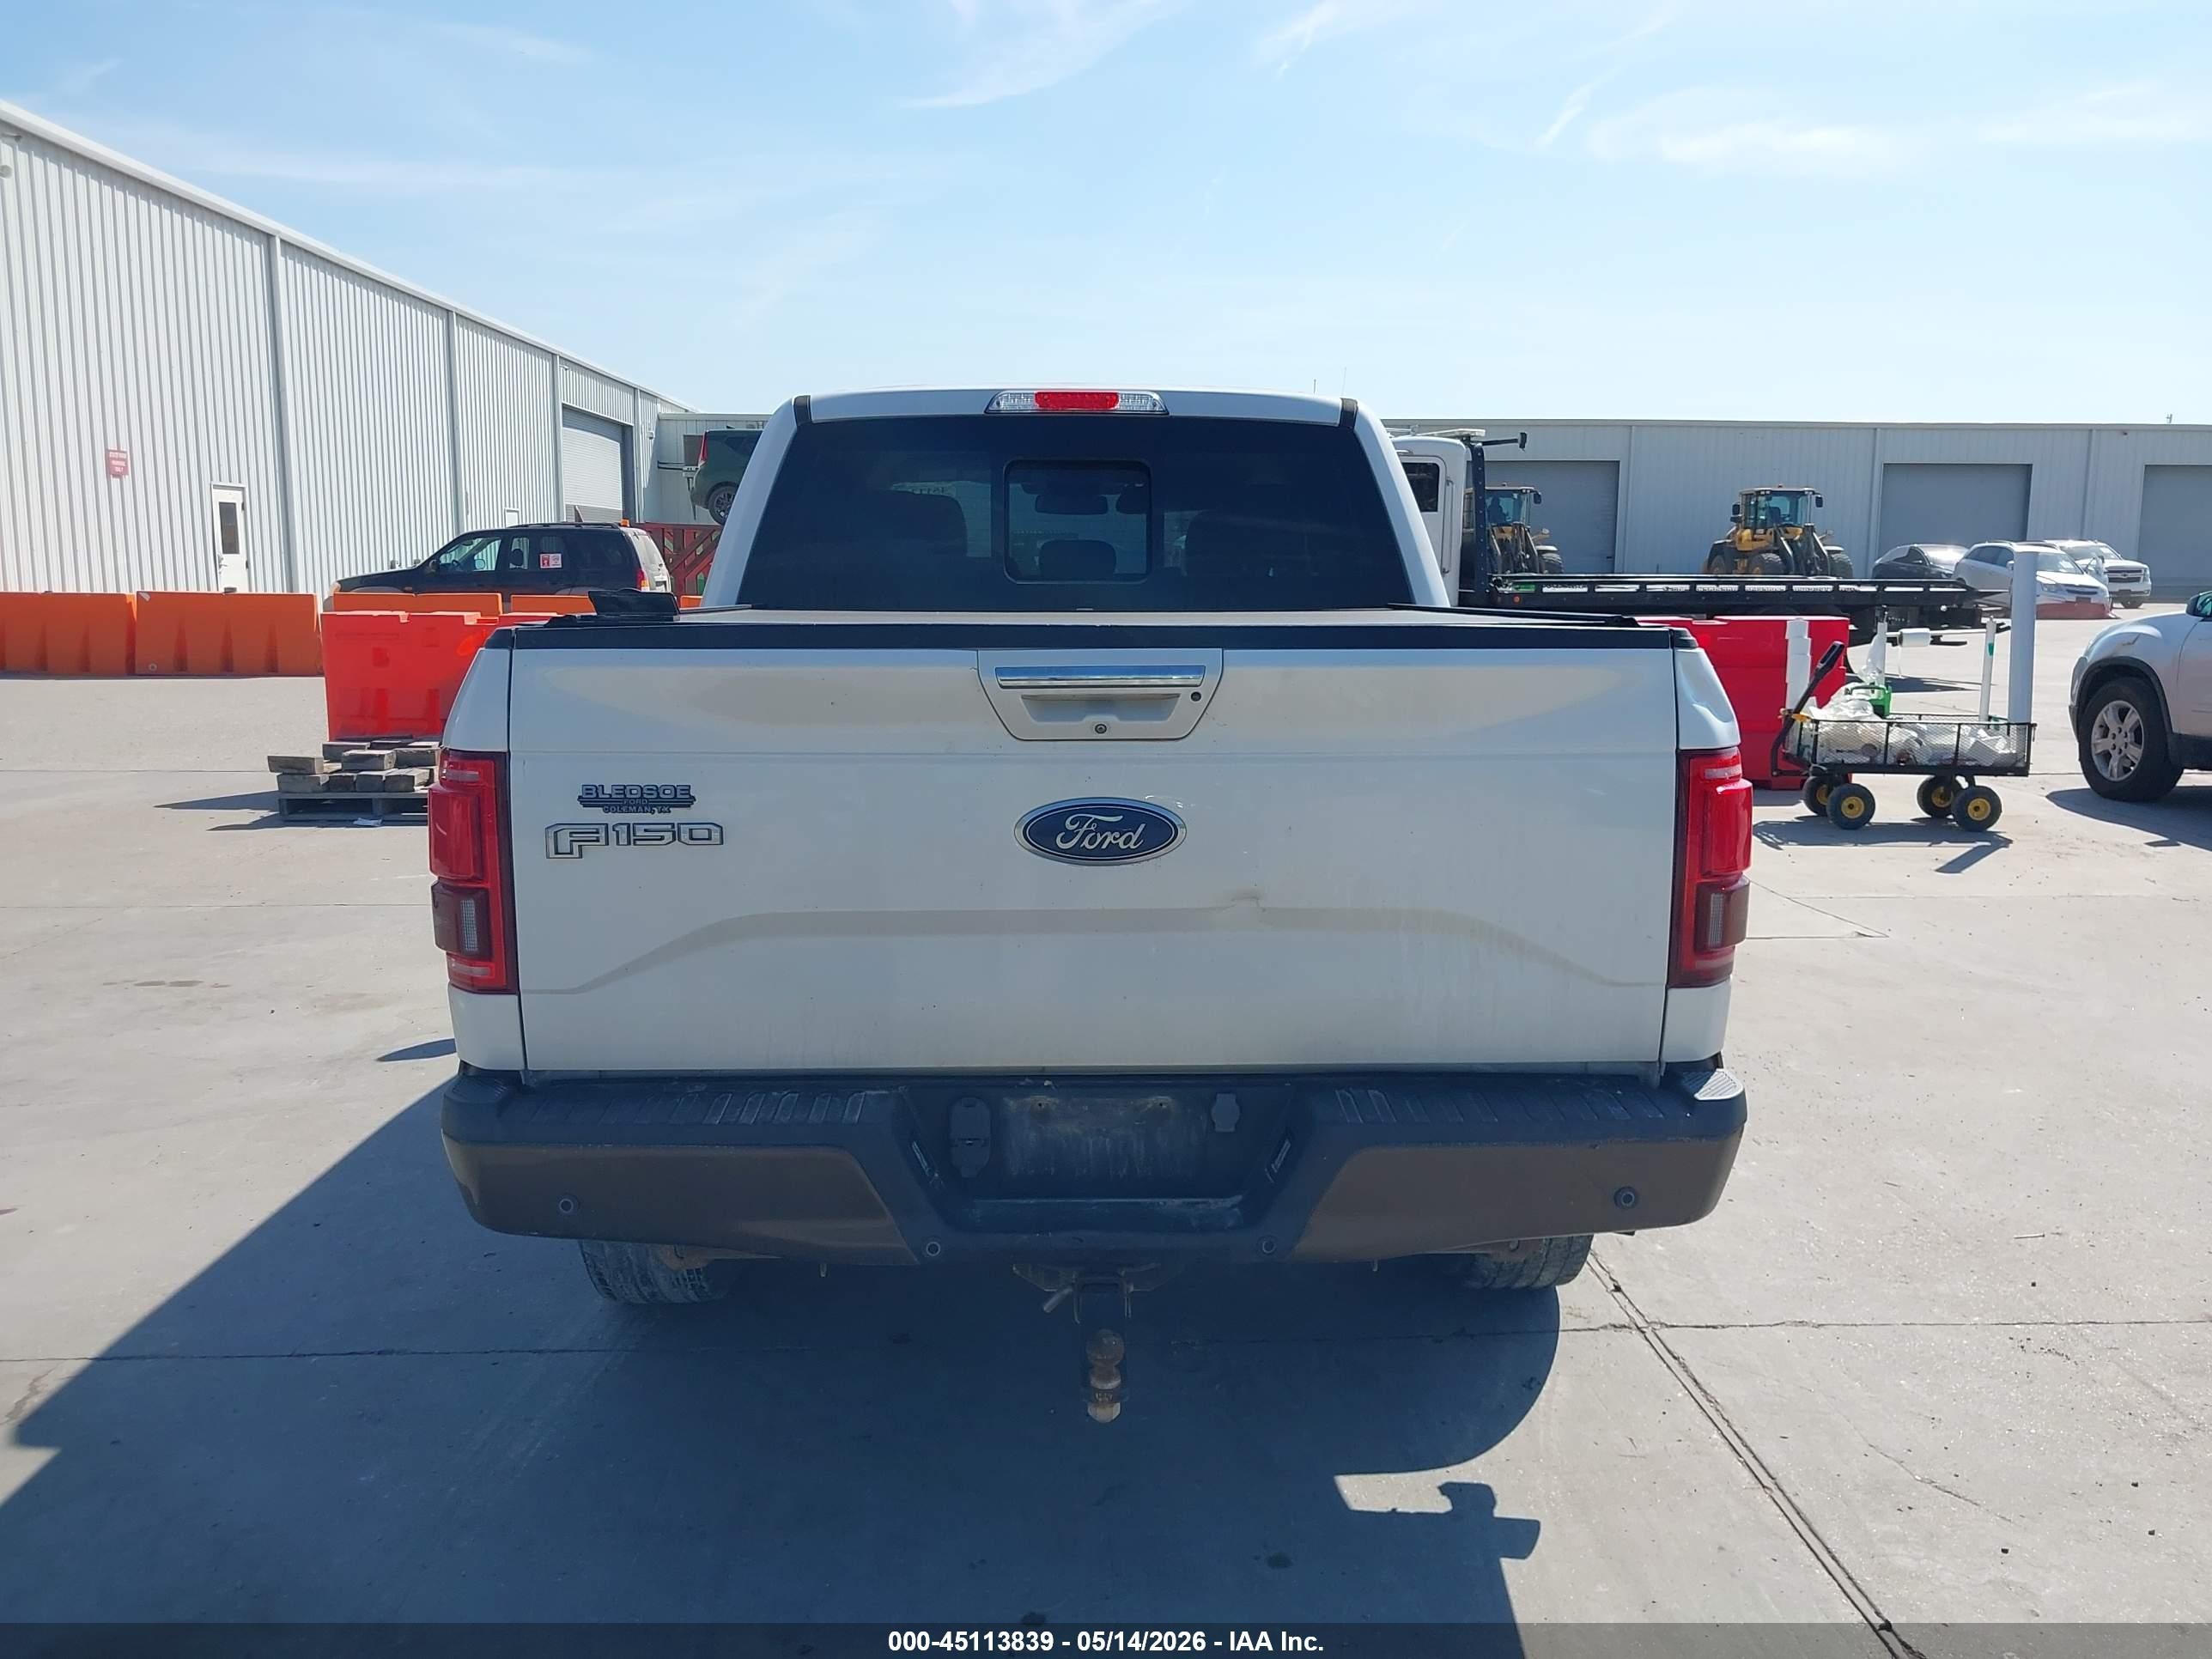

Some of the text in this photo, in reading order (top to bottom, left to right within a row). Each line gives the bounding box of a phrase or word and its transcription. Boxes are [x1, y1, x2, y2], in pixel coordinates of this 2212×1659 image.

[582, 785, 691, 799] BLEDSOE
[603, 805, 654, 814] COLEMAN,
[545, 823, 724, 859] F150
[1055, 813, 1146, 849] Ford
